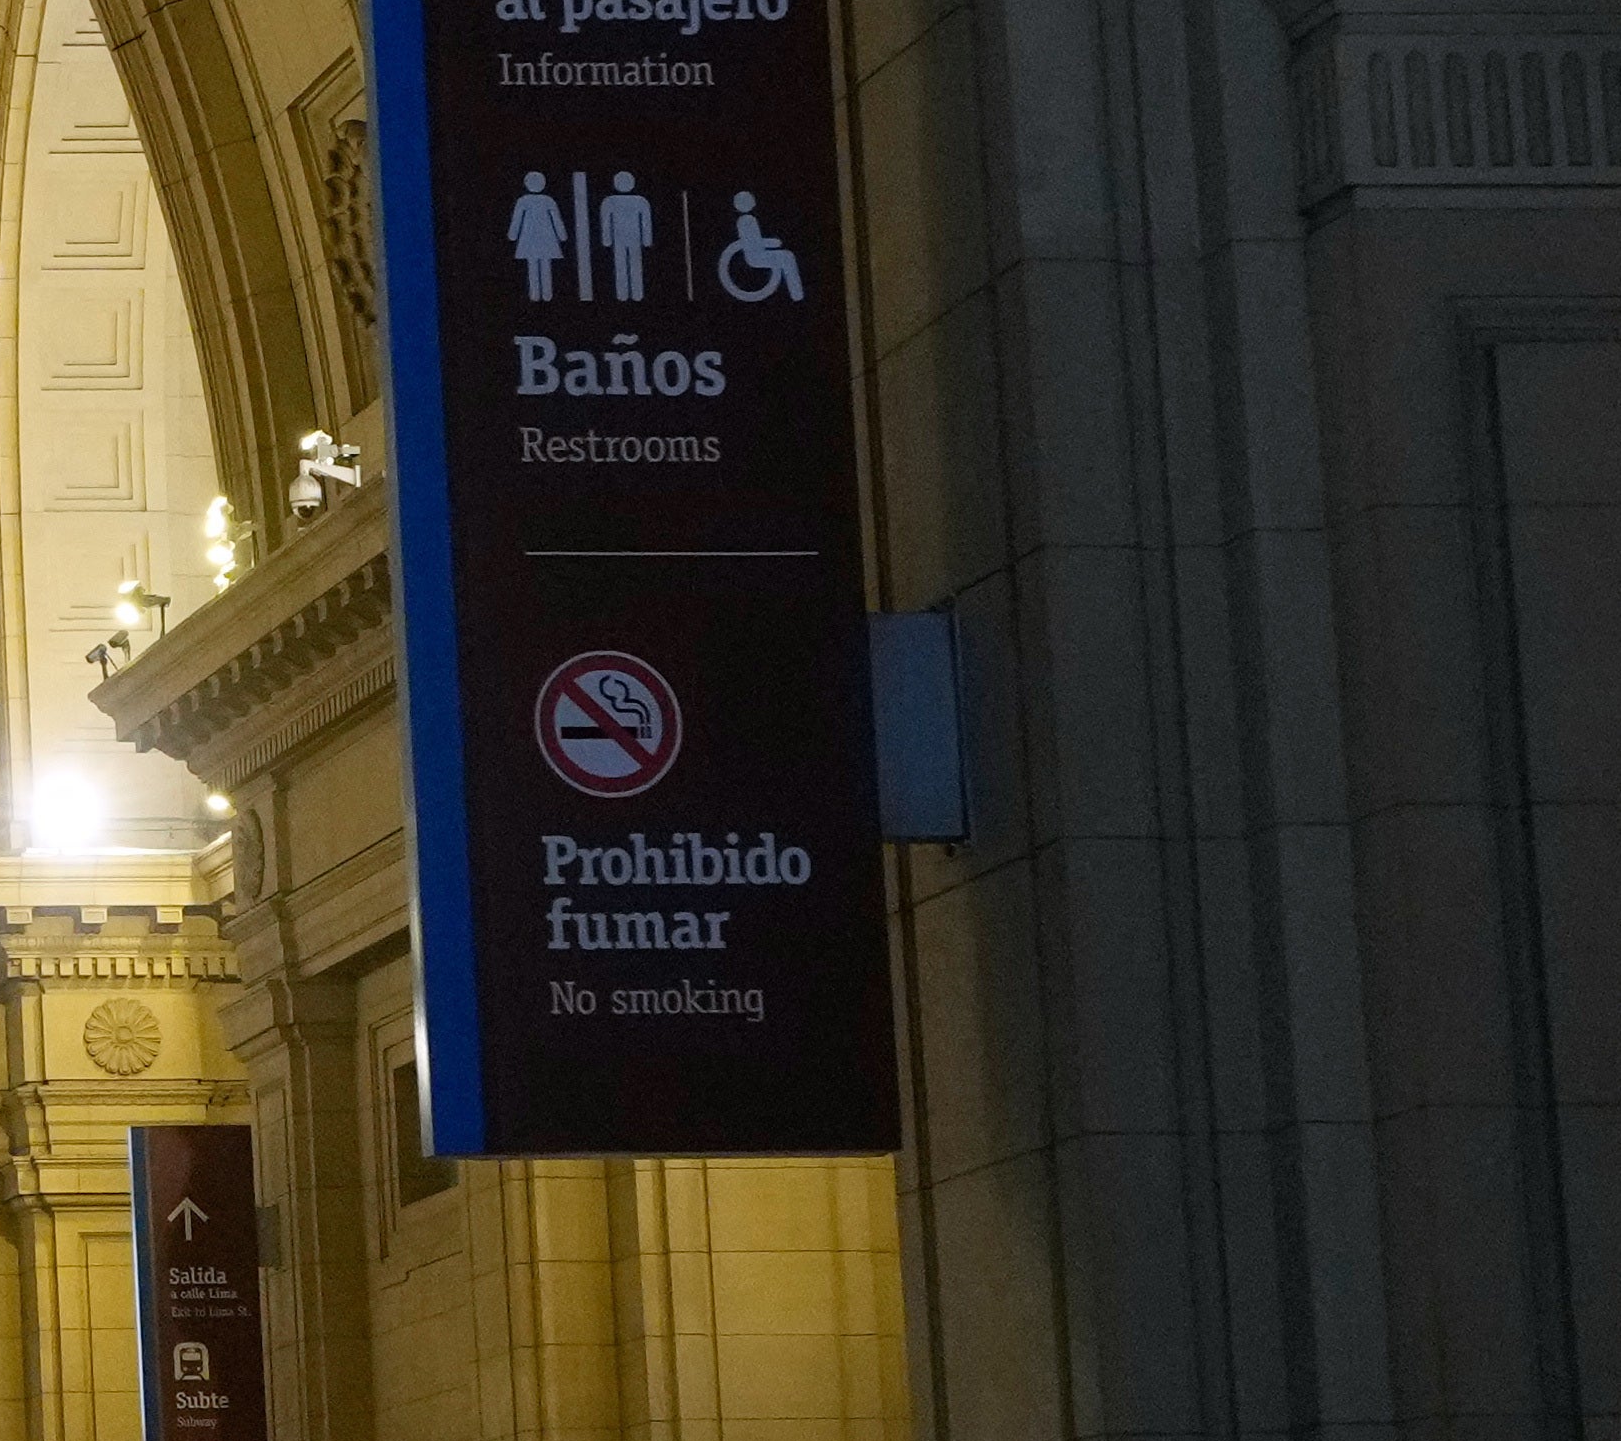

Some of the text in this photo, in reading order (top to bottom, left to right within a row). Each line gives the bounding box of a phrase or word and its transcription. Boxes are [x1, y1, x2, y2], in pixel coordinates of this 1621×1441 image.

[498, 52, 714, 86] Information
[514, 334, 725, 396] Baños
[520, 427, 720, 462] Restrooms
[542, 833, 810, 885] Prohibido
[546, 897, 730, 950] fumar
[550, 979, 764, 1022] No smoking
[169, 1267, 228, 1285] Salida
[171, 1287, 238, 1299] a calle Lima
[176, 1391, 229, 1409] Subte
[177, 1416, 218, 1429] Subway
